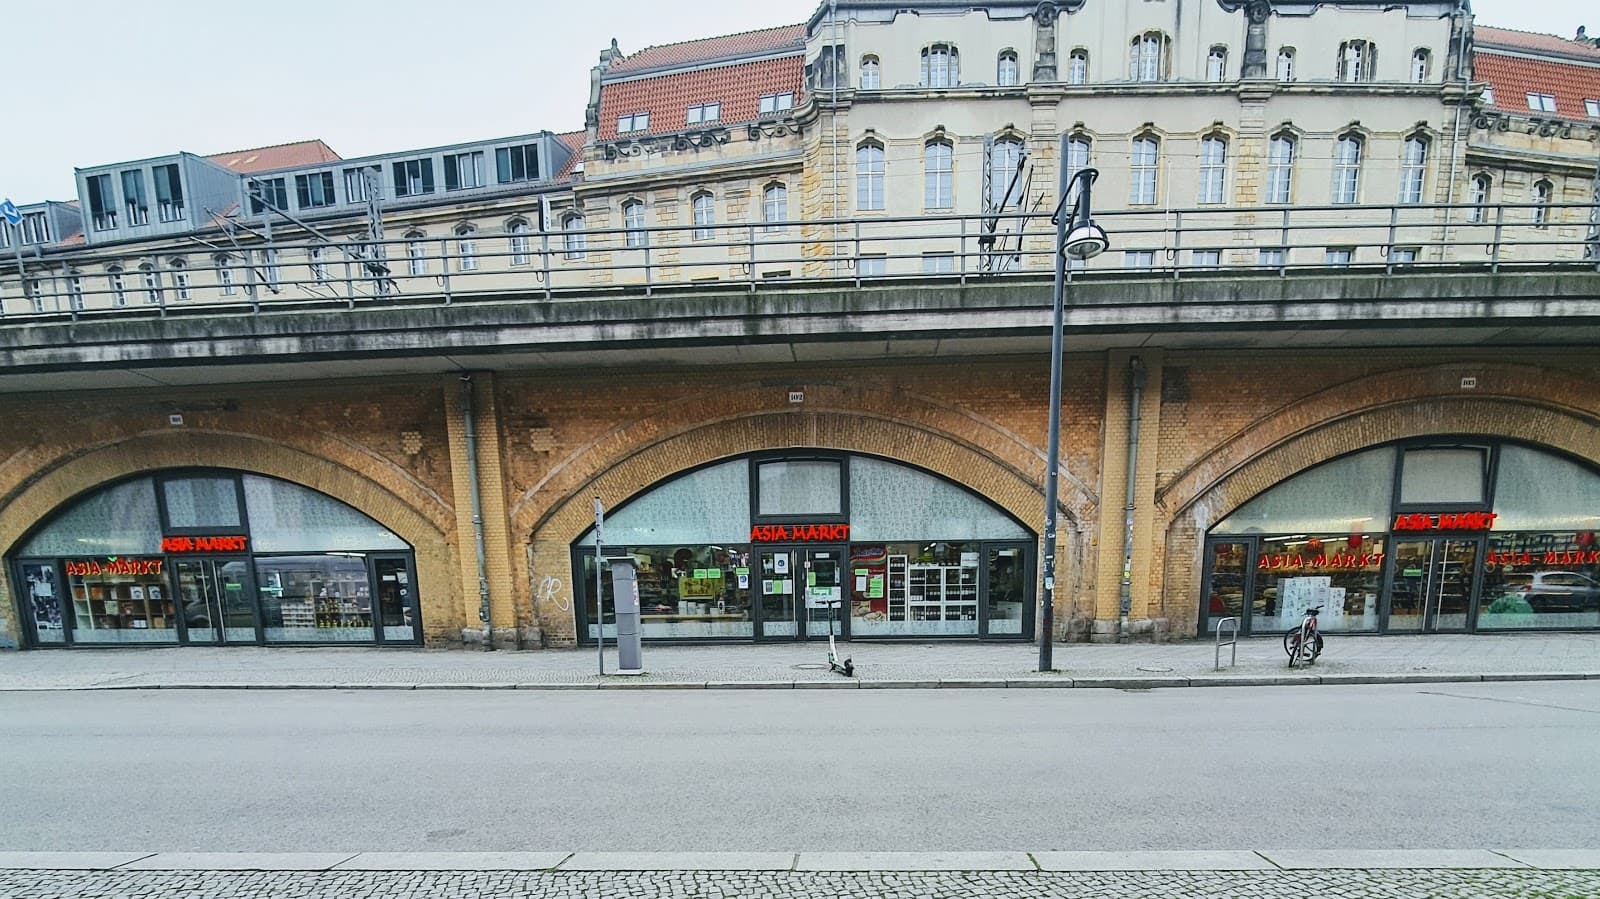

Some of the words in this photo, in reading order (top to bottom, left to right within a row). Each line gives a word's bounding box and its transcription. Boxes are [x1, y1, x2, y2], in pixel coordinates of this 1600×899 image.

[1393, 513, 1433, 530] ASIA
[1436, 511, 1497, 530] MARKT
[750, 524, 788, 541] ASIA
[792, 524, 851, 541] MARKT
[160, 537, 193, 552] ASIA
[194, 536, 246, 551] MARKT
